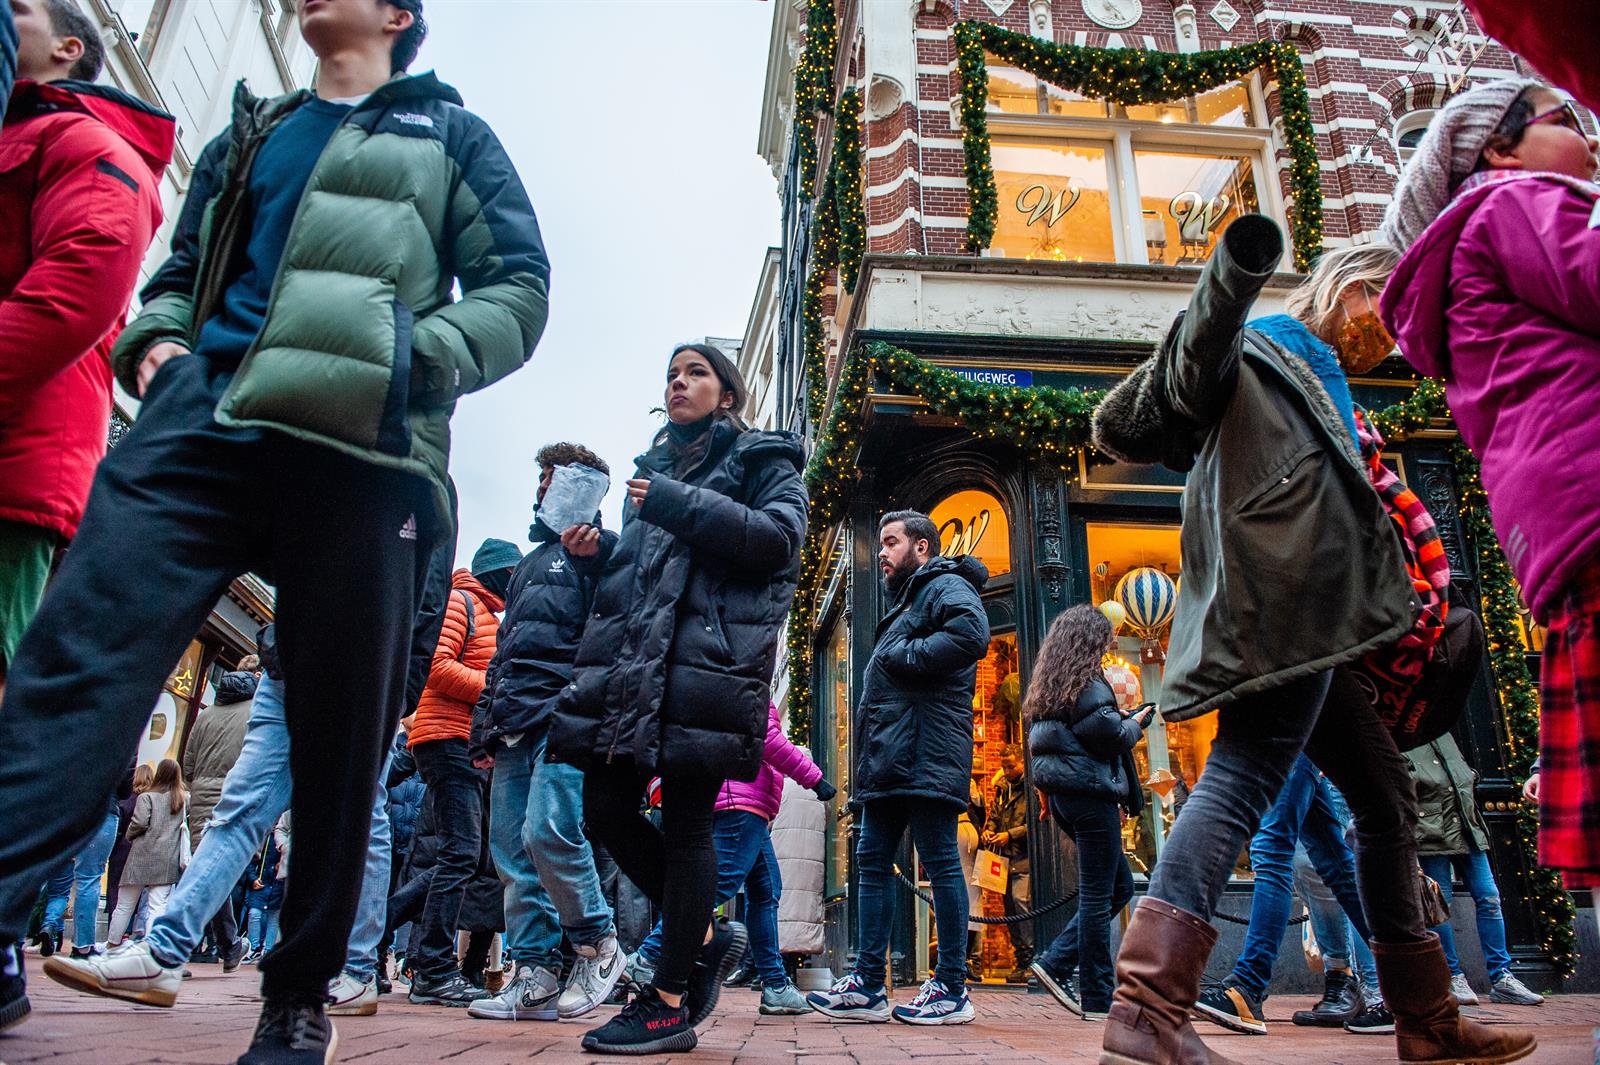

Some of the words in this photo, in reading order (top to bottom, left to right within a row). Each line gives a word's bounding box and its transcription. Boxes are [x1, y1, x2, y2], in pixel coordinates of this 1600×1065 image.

[1016, 183, 1081, 228] W
[1169, 191, 1230, 235] W
[954, 371, 1016, 385] EILIGEWEG
